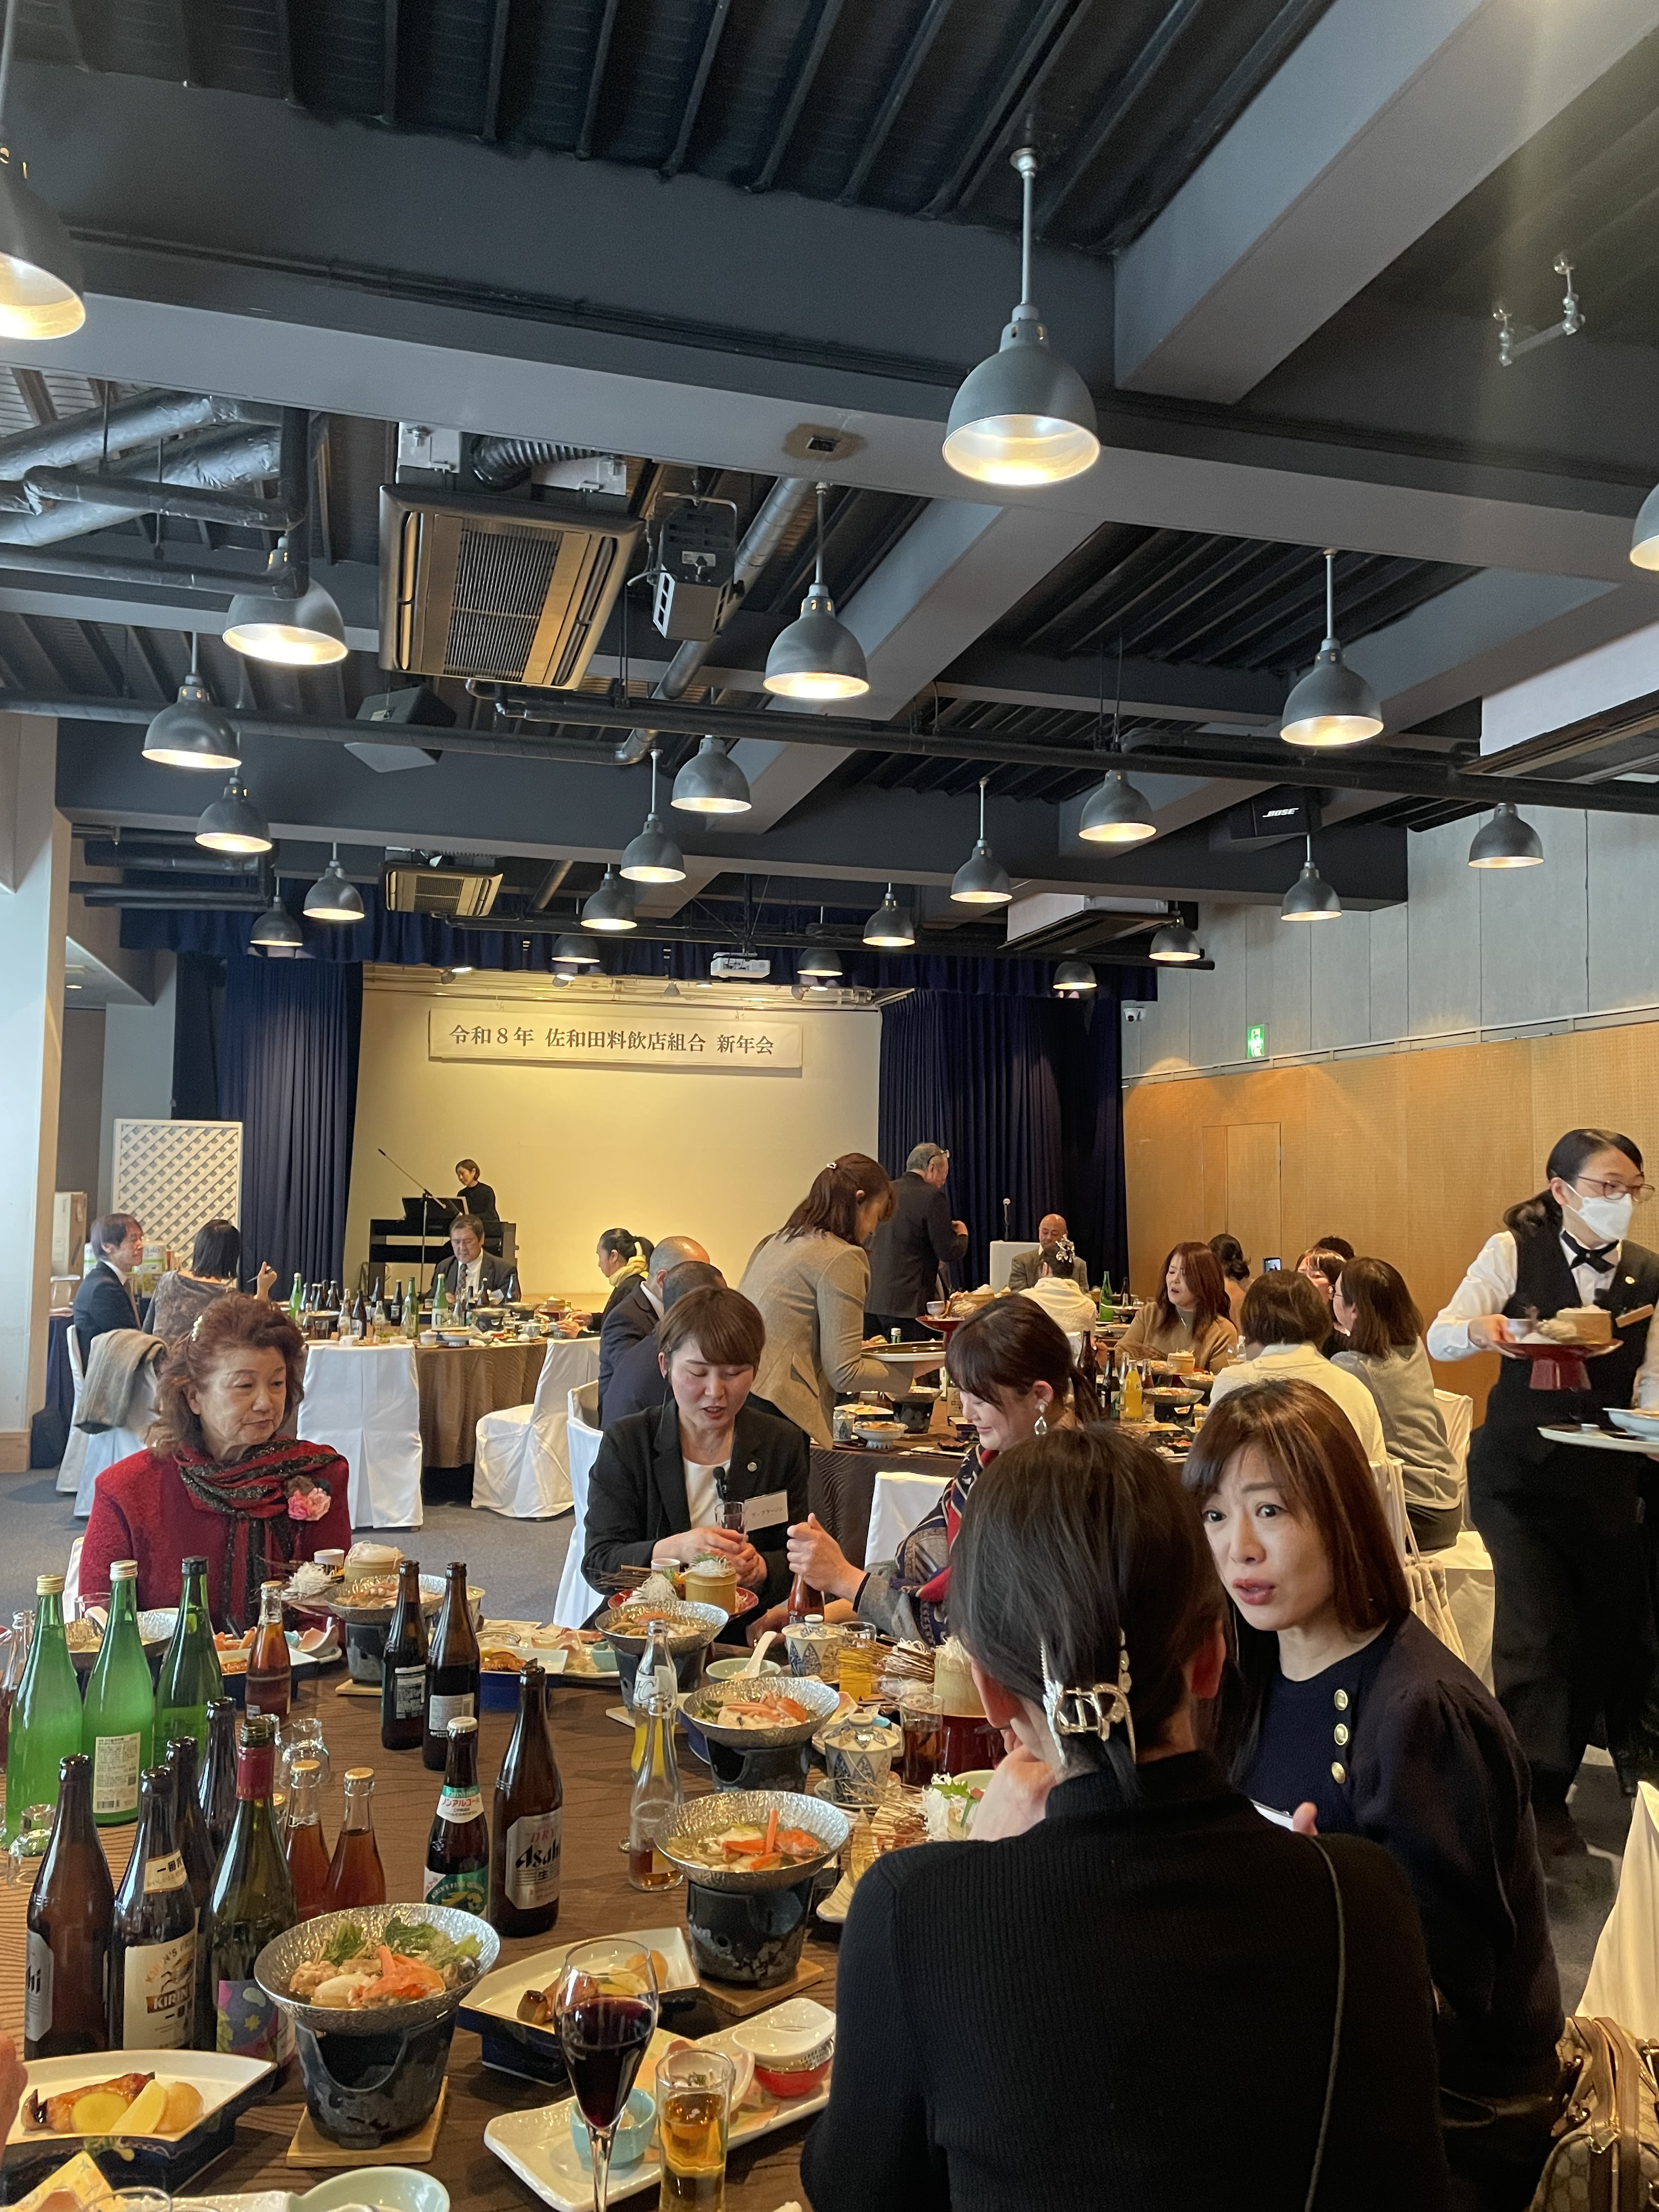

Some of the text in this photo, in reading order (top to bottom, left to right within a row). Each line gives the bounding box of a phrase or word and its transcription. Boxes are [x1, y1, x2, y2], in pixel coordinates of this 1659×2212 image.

[1262, 808, 1299, 817] BOSE
[449, 1024, 774, 1055] 令和8年 佐和田料飲店組合 新年会
[516, 1838, 559, 1868] Asah
[157, 1857, 182, 1872] 一番
[538, 1870, 549, 1881] 生
[153, 1987, 189, 2010] KIRIN
